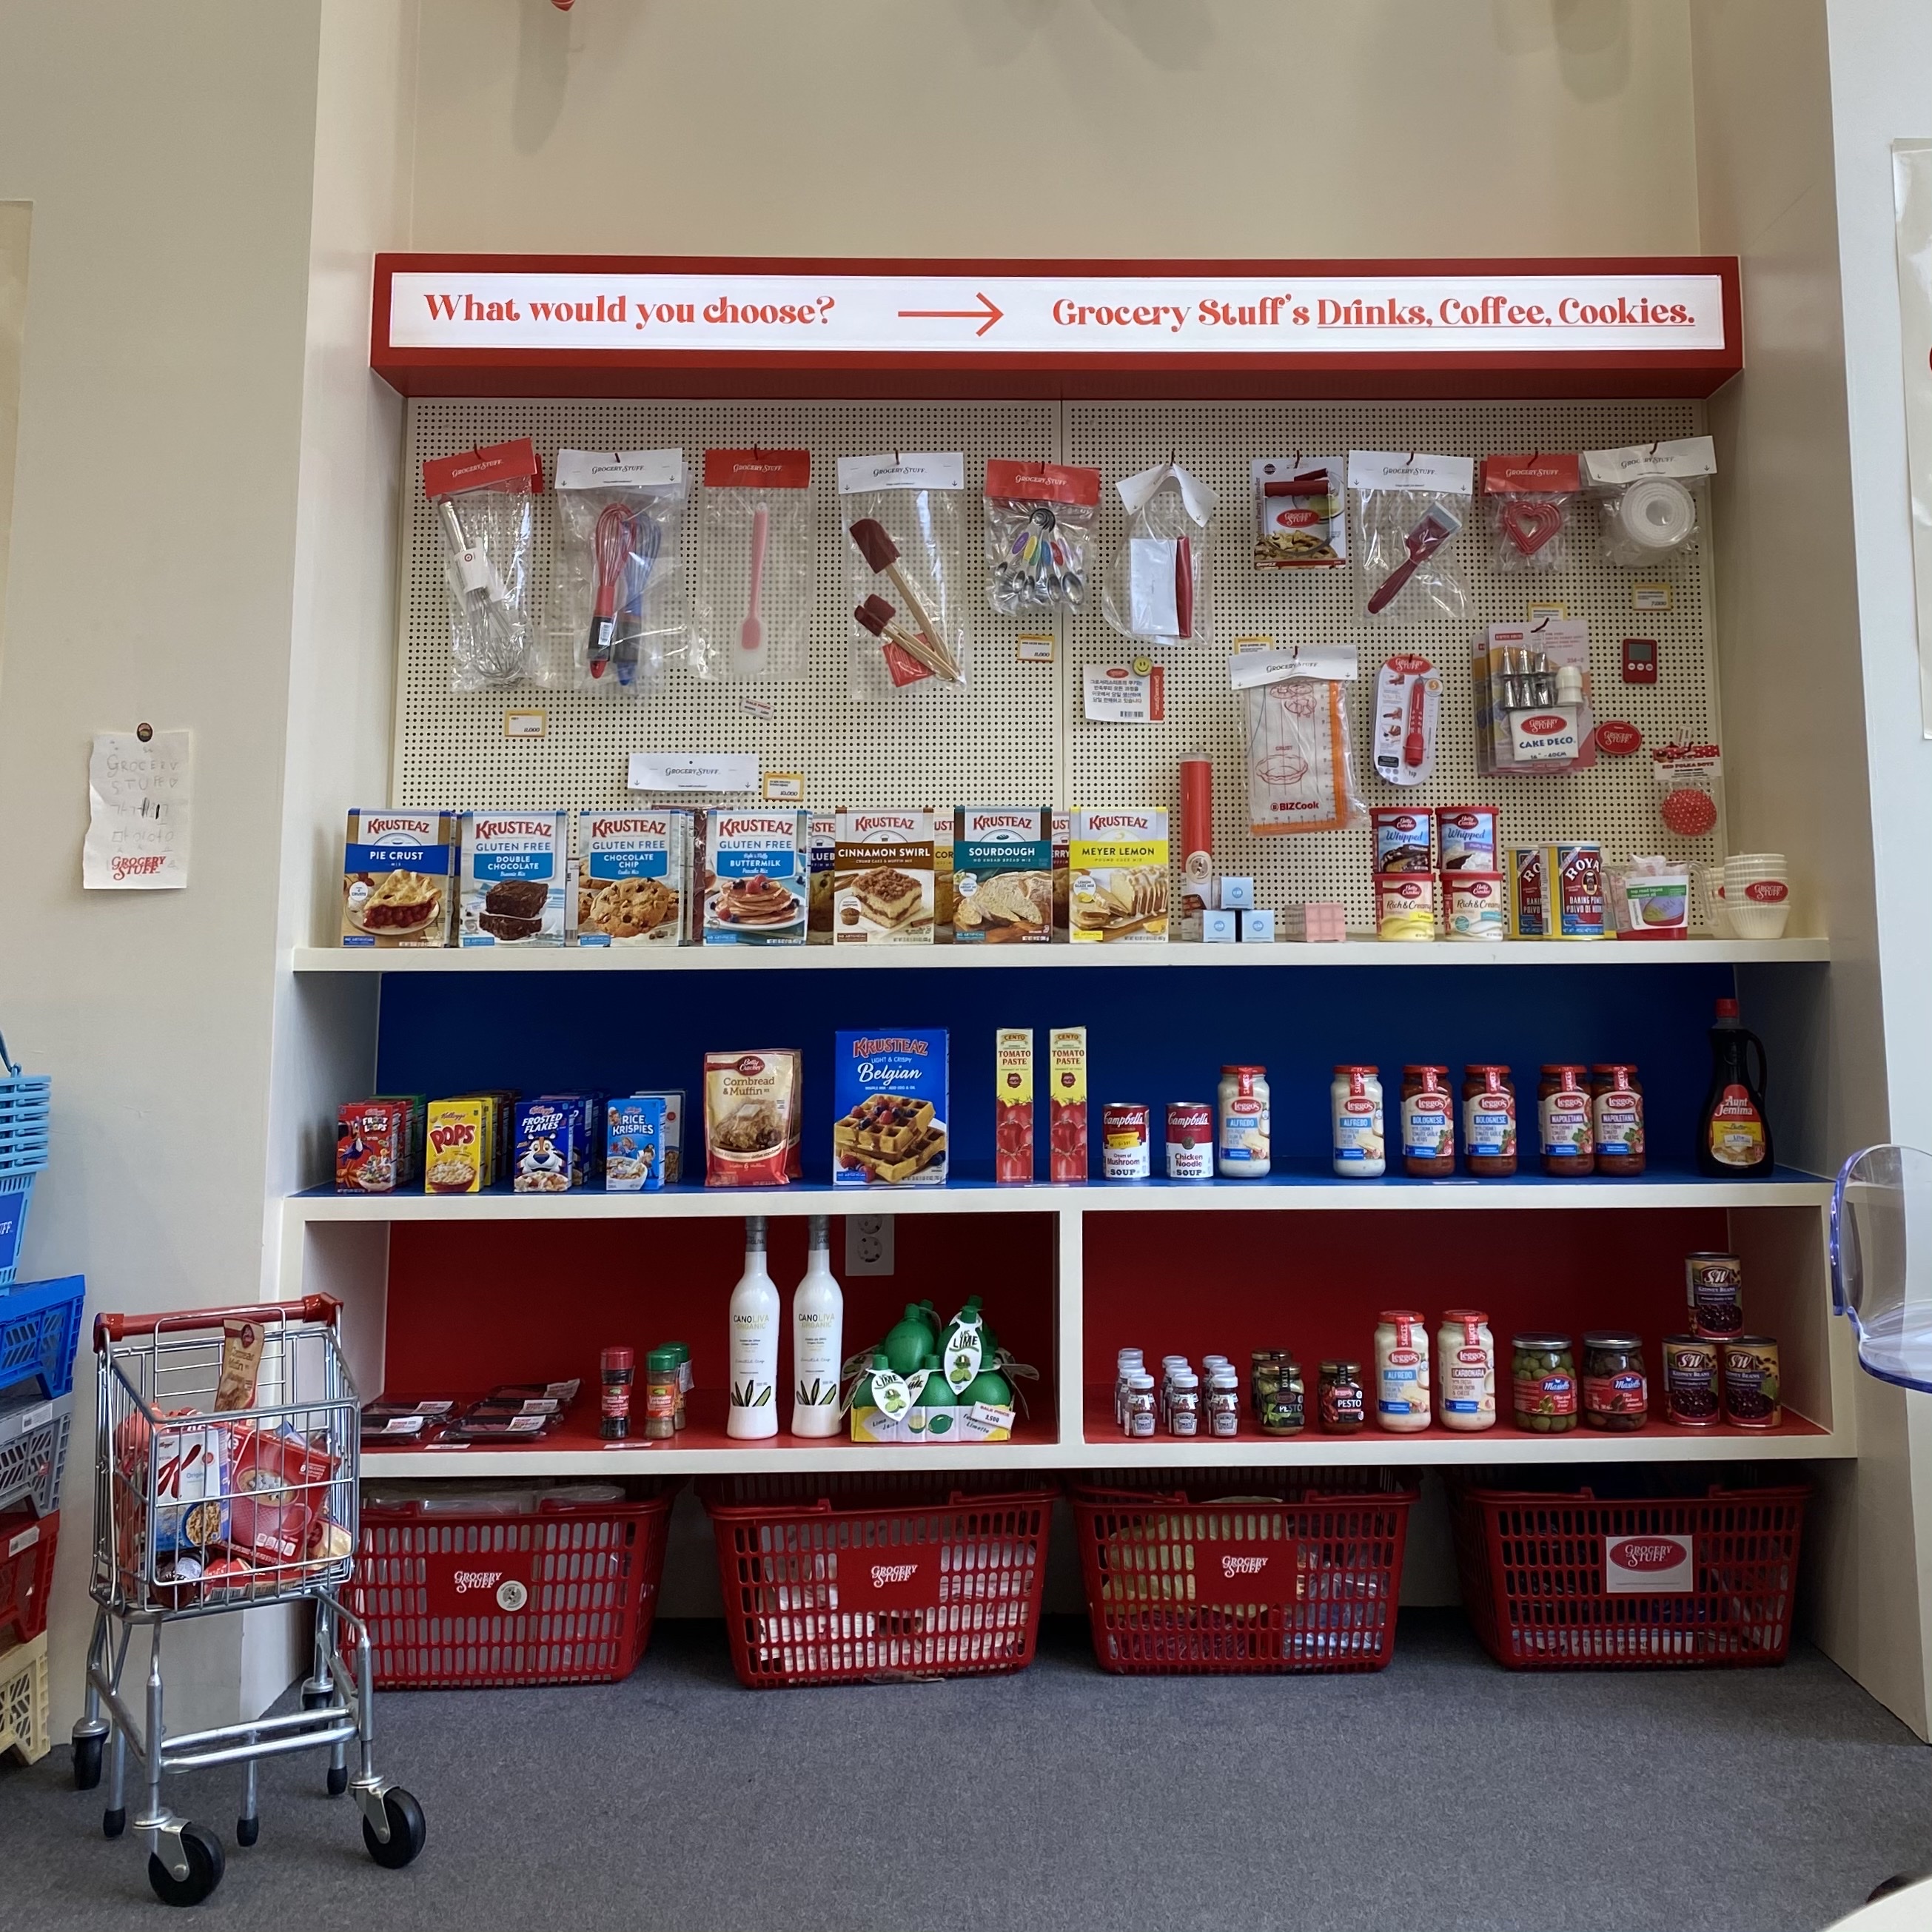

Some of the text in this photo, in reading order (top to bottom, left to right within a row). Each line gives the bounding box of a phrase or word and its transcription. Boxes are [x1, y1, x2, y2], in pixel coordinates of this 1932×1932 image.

[424, 294, 836, 330] What would you choose?
[1053, 294, 1695, 332] Grocery Stuff's Drinks, Coffee, Cookies.
[452, 459, 503, 477] GROCERY STUFF
[1621, 456, 1675, 469] GROCERY STUFF
[592, 465, 645, 474] GROCERY STUFF
[733, 464, 782, 473] GROCERY STUFF
[873, 466, 927, 477] GROCERY STUFF
[1383, 467, 1414, 476] GROCERY
[1506, 469, 1559, 477] GROCERY STUFF
[1015, 474, 1068, 486] GROCERY STUFF
[1284, 511, 1313, 521] GROCERY
[1287, 515, 1309, 526] STUFF
[1267, 663, 1295, 673] GROCERY
[1396, 661, 1420, 671] STUFF
[1529, 719, 1560, 728] GROCERY
[1532, 722, 1554, 731] STUFF
[1603, 730, 1634, 739] GROCERY
[1605, 734, 1629, 745] STUFF
[1519, 736, 1574, 749] CAKE DECO
[665, 768, 720, 776] GROCERY STUFF
[1279, 801, 1319, 811] BIZCook
[367, 818, 430, 834] KRUSTEAZ
[591, 819, 666, 837] KRUSTEAZ
[719, 819, 794, 837] KRUSTEAZ
[855, 816, 915, 832] KRUSTEAZ
[973, 815, 1032, 831] KRUSTEAZ
[1089, 815, 1148, 831] KRUSTEAZ
[475, 820, 552, 839] KRUSTEAZ
[1448, 828, 1486, 839] Whipped
[1386, 830, 1423, 842] Whipped
[476, 842, 551, 851] GLUTEN FREE
[592, 840, 665, 850] GLUTEN FREE
[719, 840, 792, 849] GLUTEN FREE
[369, 851, 423, 861] PIE CRUST
[603, 853, 654, 862] CHOCOLATE
[838, 848, 898, 858] CINNAMON
[899, 848, 930, 856] SWIRL
[969, 848, 1035, 856] SOURDOUGH
[1082, 848, 1155, 856] MEYER LEMON
[111, 856, 167, 871] GROCERY
[488, 862, 539, 871] CHOCOLATE
[730, 859, 781, 868] BUTTERMILK
[113, 865, 160, 881] STUFF
[1566, 858, 1600, 881] ROYA
[1754, 884, 1783, 893] GROCERY
[1569, 896, 1590, 905] BAKING
[1756, 890, 1780, 900] STUFF
[1386, 899, 1403, 909] Rich
[1457, 899, 1475, 909] Rich
[1566, 905, 1584, 913] POLVO
[853, 1037, 928, 1058] KRUSTEAZ
[743, 1058, 759, 1067] Betty
[857, 1062, 922, 1086] Belgian
[723, 1076, 775, 1087] Cornbread
[729, 1086, 763, 1096] Muffin
[1234, 1101, 1260, 1112] Leggo's
[1347, 1101, 1374, 1112] Leggo's
[1418, 1099, 1444, 1110] Leggo's
[1480, 1099, 1507, 1109] Leggo's
[1557, 1097, 1583, 1107] Leggo's
[1609, 1096, 1635, 1107] Leggo's
[1725, 1096, 1747, 1107] Aunt
[1714, 1104, 1753, 1117] Jemima
[521, 1113, 563, 1127] FROSTED
[622, 1114, 645, 1124] RICE
[1343, 1118, 1368, 1127] ALFREDO
[1412, 1116, 1443, 1124] BOLOGNESE
[1475, 1116, 1506, 1124] BOLOGNESE
[523, 1121, 560, 1134] FLAKES
[612, 1124, 654, 1136] KRISPIES
[429, 1124, 477, 1155] POPS
[1175, 1153, 1203, 1161] Chicken
[1110, 1168, 1136, 1176] SOUP
[734, 1314, 770, 1323] CANOLIVA
[799, 1313, 835, 1322] CANOLIVA
[953, 1335, 978, 1349] LIME
[1391, 1352, 1419, 1364] Leggo's
[1459, 1351, 1486, 1362] Leggo's
[1387, 1371, 1413, 1379] ALFREDO
[1455, 1369, 1485, 1377] CARBONARA
[876, 1375, 899, 1387] LIME
[1278, 1403, 1303, 1412] PESTO
[1338, 1399, 1362, 1408] PESTO
[1625, 1544, 1672, 1557] GROCERY
[1221, 1555, 1269, 1569] GROCERY
[1628, 1552, 1666, 1568] STUFF
[871, 1564, 919, 1579] GROCERY
[1224, 1564, 1262, 1578] STUFF
[454, 1571, 503, 1584] GROCERY
[873, 1572, 911, 1588] STUFF
[456, 1579, 495, 1594] STUFF
